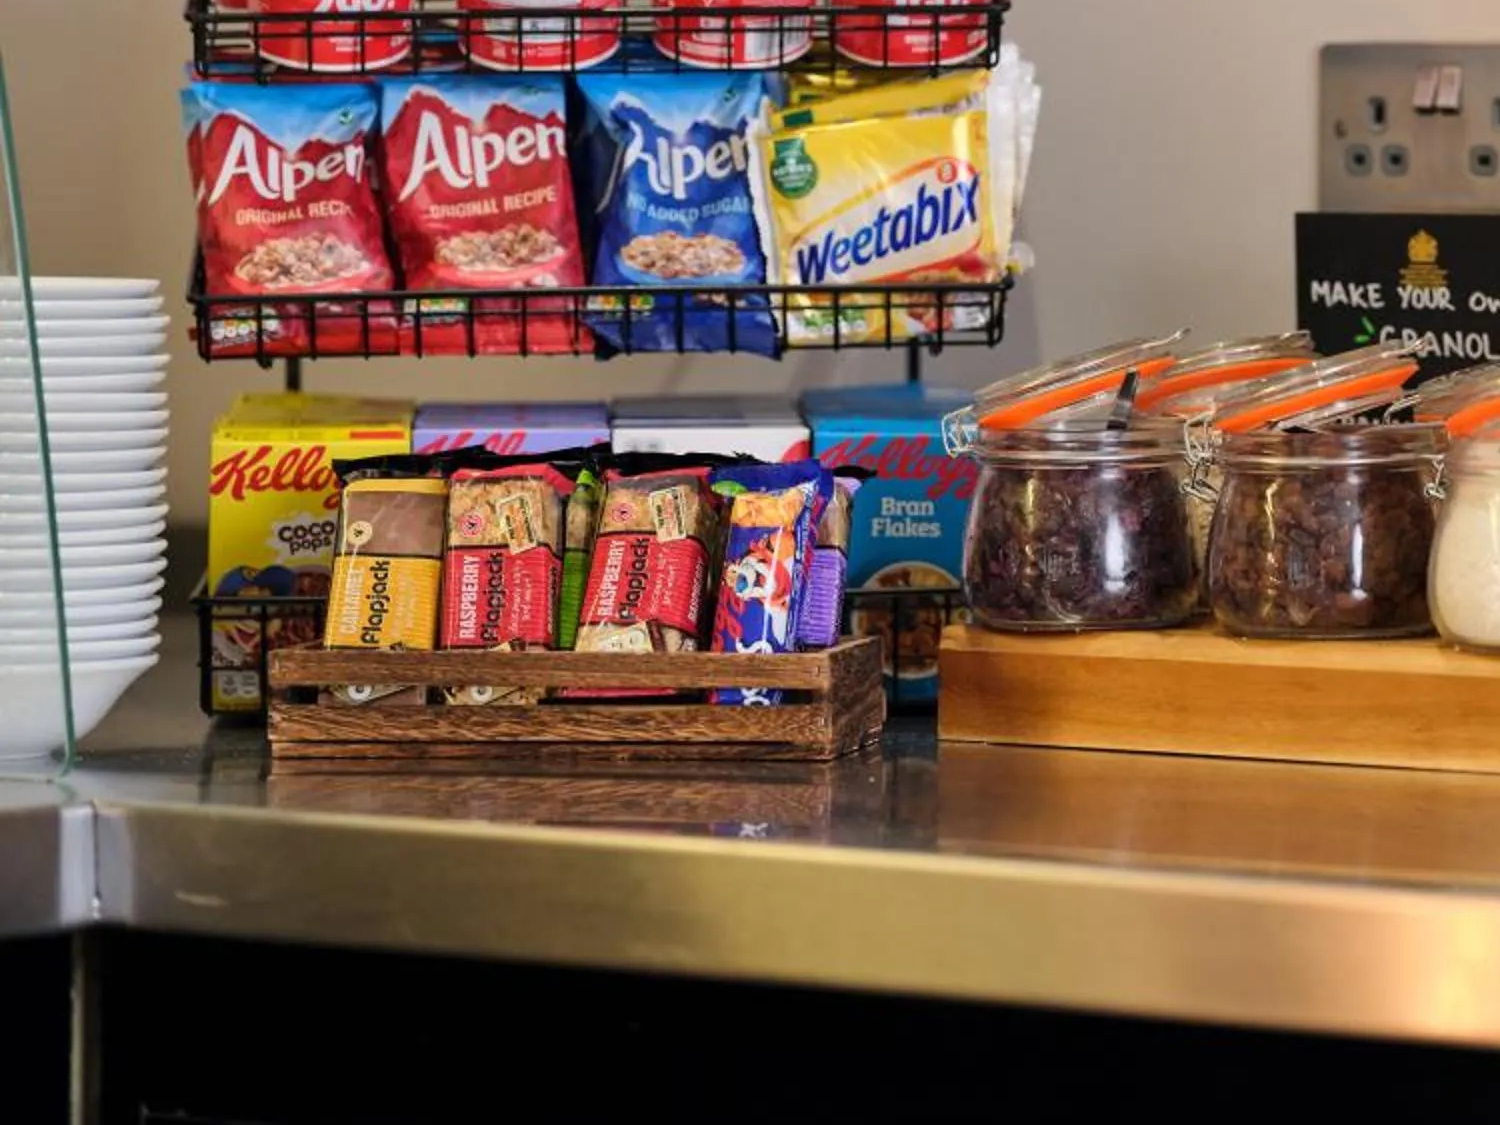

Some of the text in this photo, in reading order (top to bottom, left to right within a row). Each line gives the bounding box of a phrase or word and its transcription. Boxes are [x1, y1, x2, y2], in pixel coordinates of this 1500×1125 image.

[207, 123, 366, 206] Alpen
[398, 110, 567, 202] Alpen
[235, 207, 303, 226] ORIGINAL
[428, 185, 557, 219] ORIGINAL RECIPE
[797, 172, 980, 285] Weetabix
[1310, 279, 1385, 309] MAKE
[1397, 284, 1456, 312] YOUR
[871, 517, 941, 538] Flakes
[880, 496, 935, 517] Bran
[360, 560, 391, 644] Flapjack
[459, 554, 480, 639] RASPBERRY
[480, 552, 507, 642] Flapjack
[597, 539, 625, 616] RASPBERRY
[618, 538, 650, 620] Flapjack
